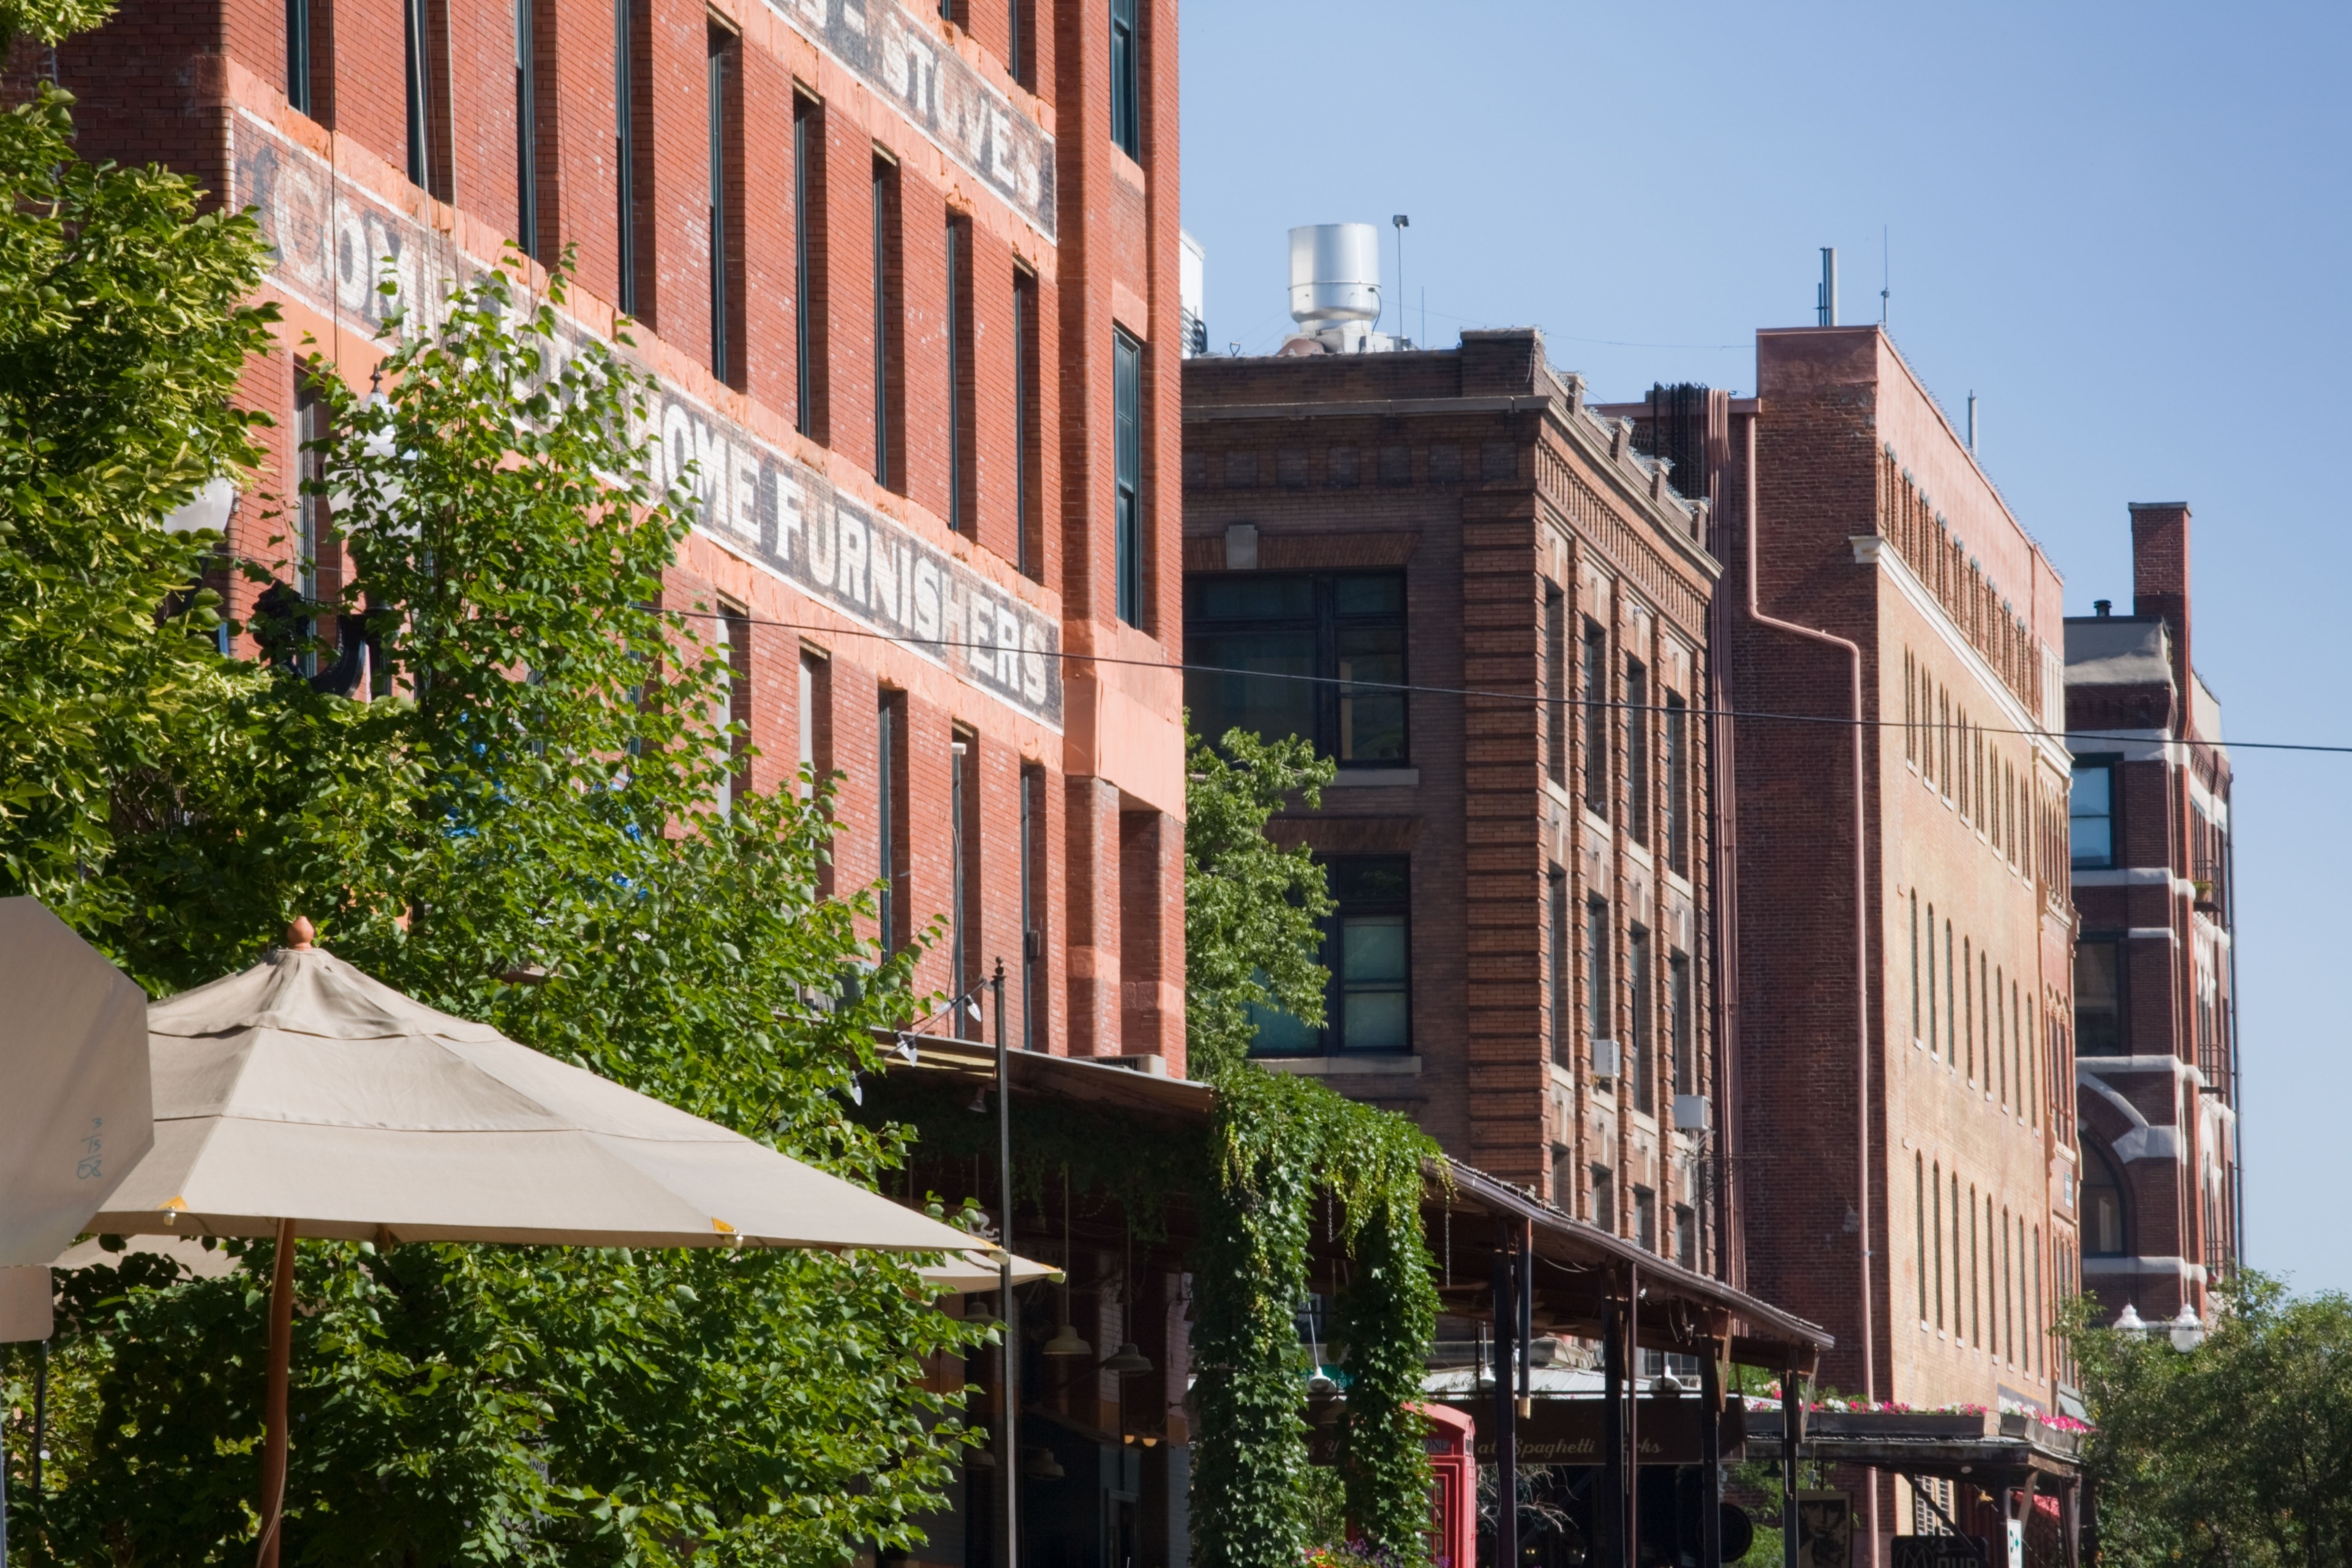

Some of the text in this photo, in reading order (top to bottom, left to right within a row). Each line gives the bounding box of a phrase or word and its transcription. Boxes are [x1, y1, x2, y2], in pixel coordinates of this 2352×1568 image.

[883, 11, 1039, 208] STOVES
[775, 473, 1048, 706] FURNISHERS
[1515, 1438, 1596, 1459] Spaghetti
